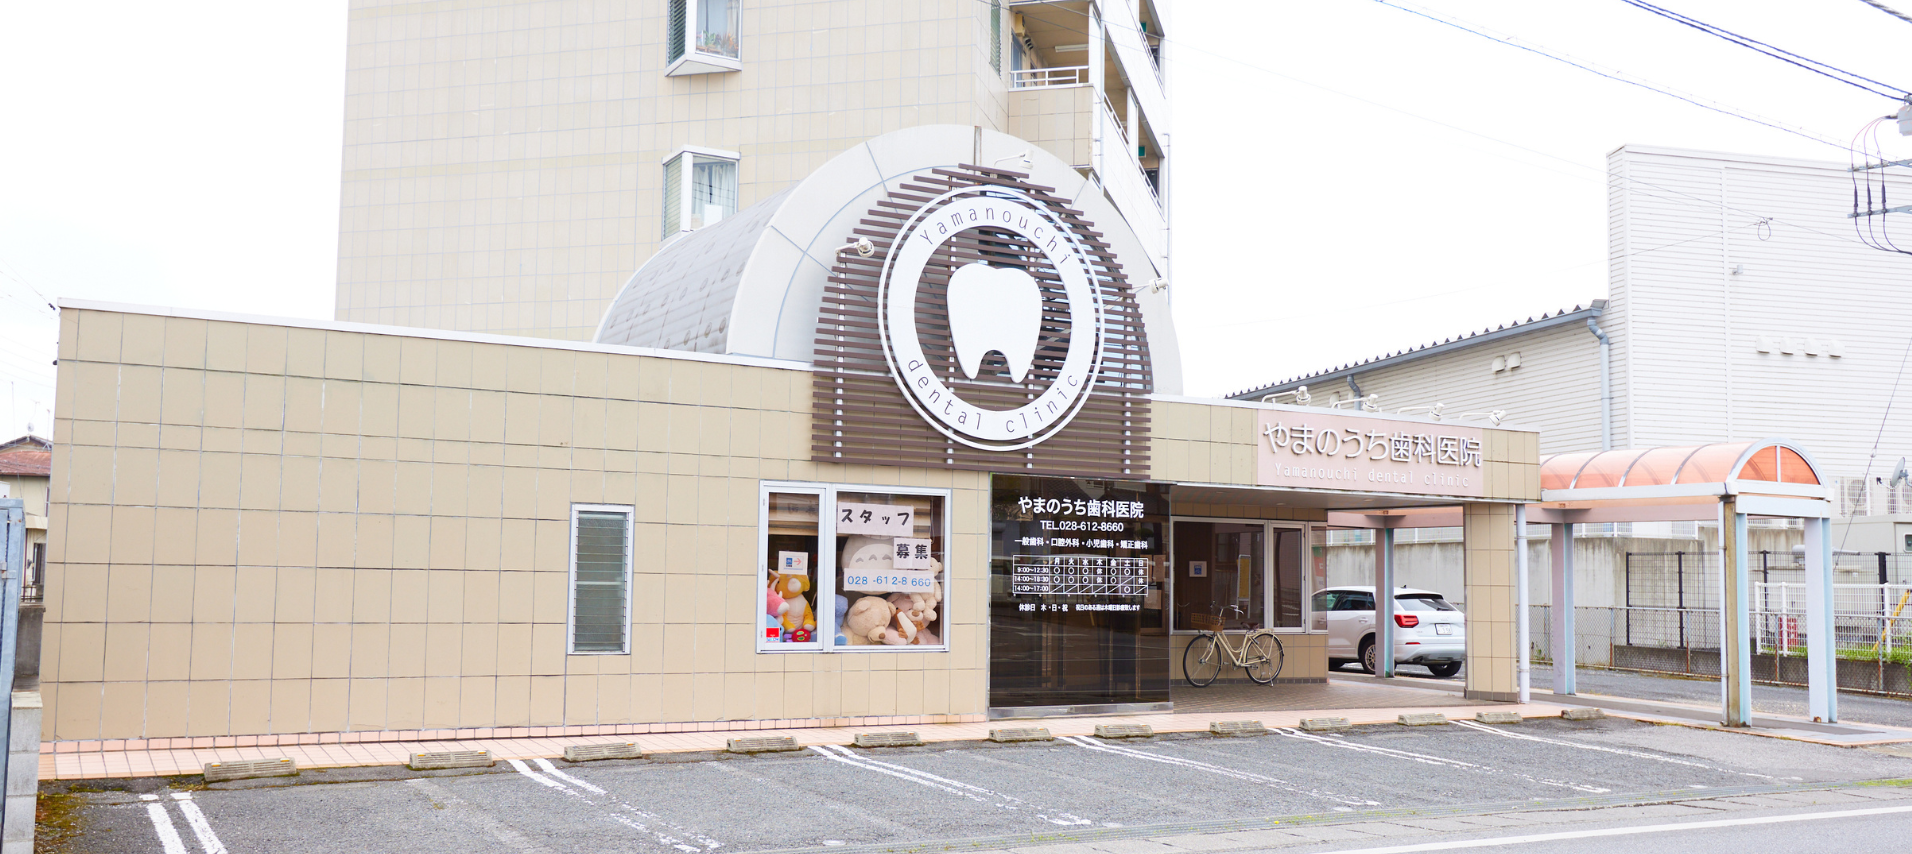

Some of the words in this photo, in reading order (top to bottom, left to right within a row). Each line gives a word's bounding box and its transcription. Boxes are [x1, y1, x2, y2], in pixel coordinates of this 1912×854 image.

[919, 205, 1071, 265] Yamanouchi
[908, 359, 982, 431] dental
[1005, 374, 1078, 433] clinic
[1263, 421, 1482, 468] やまのうち歯科医院
[1274, 463, 1358, 482] Yamanouchi
[1368, 467, 1413, 485] dental
[1424, 472, 1469, 488] clinic
[841, 508, 910, 526] スタッフ
[1018, 496, 1144, 518] やまのうち歯科医院
[896, 543, 929, 559] 募集
[1054, 557, 1060, 565] 月
[1068, 557, 1075, 565] 火
[1096, 558, 1103, 566] 木
